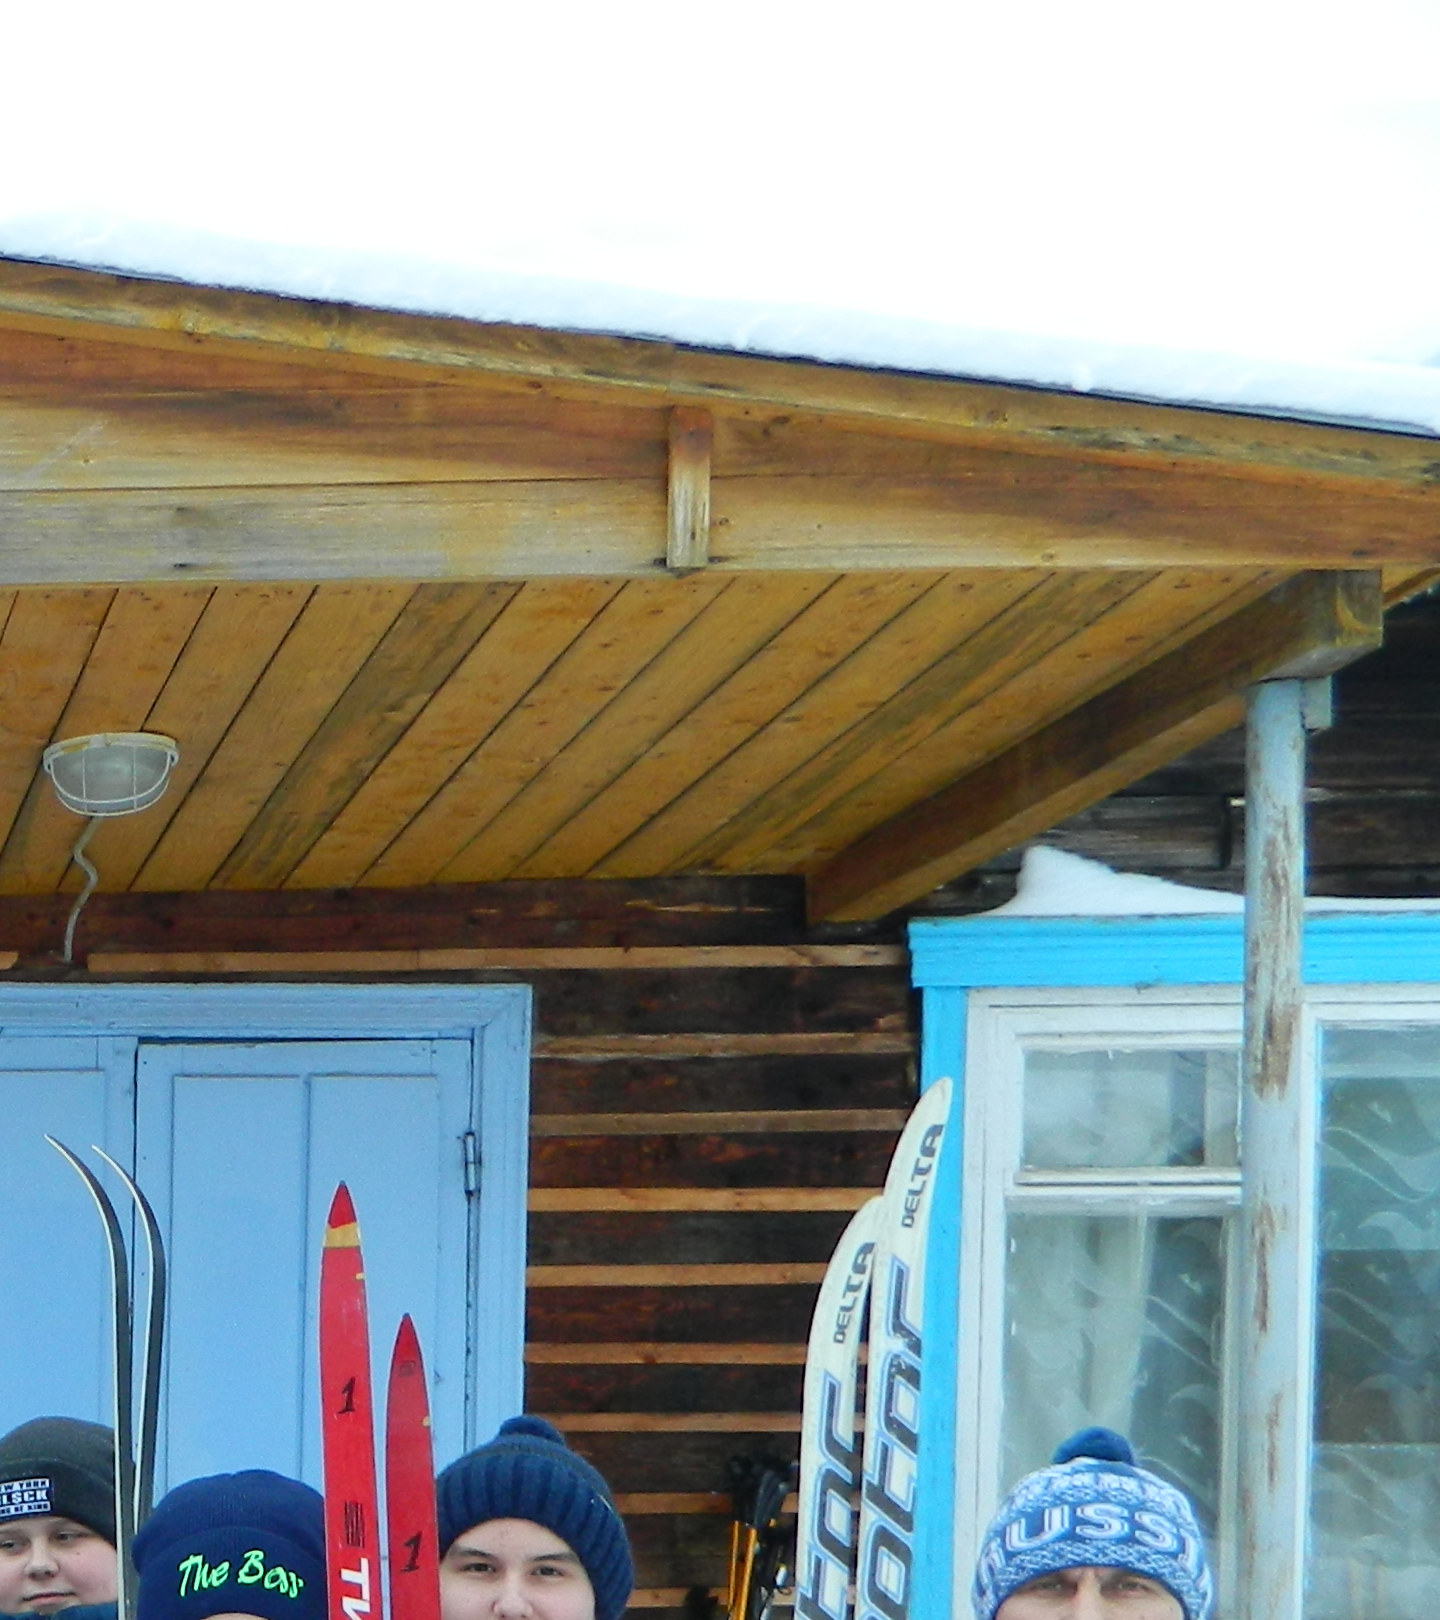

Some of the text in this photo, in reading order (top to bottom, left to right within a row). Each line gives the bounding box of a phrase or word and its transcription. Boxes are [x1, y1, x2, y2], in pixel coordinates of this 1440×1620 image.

[901, 1124, 944, 1228] DELTA
[833, 1243, 875, 1344] DELTA
[178, 1555, 230, 1597] The
